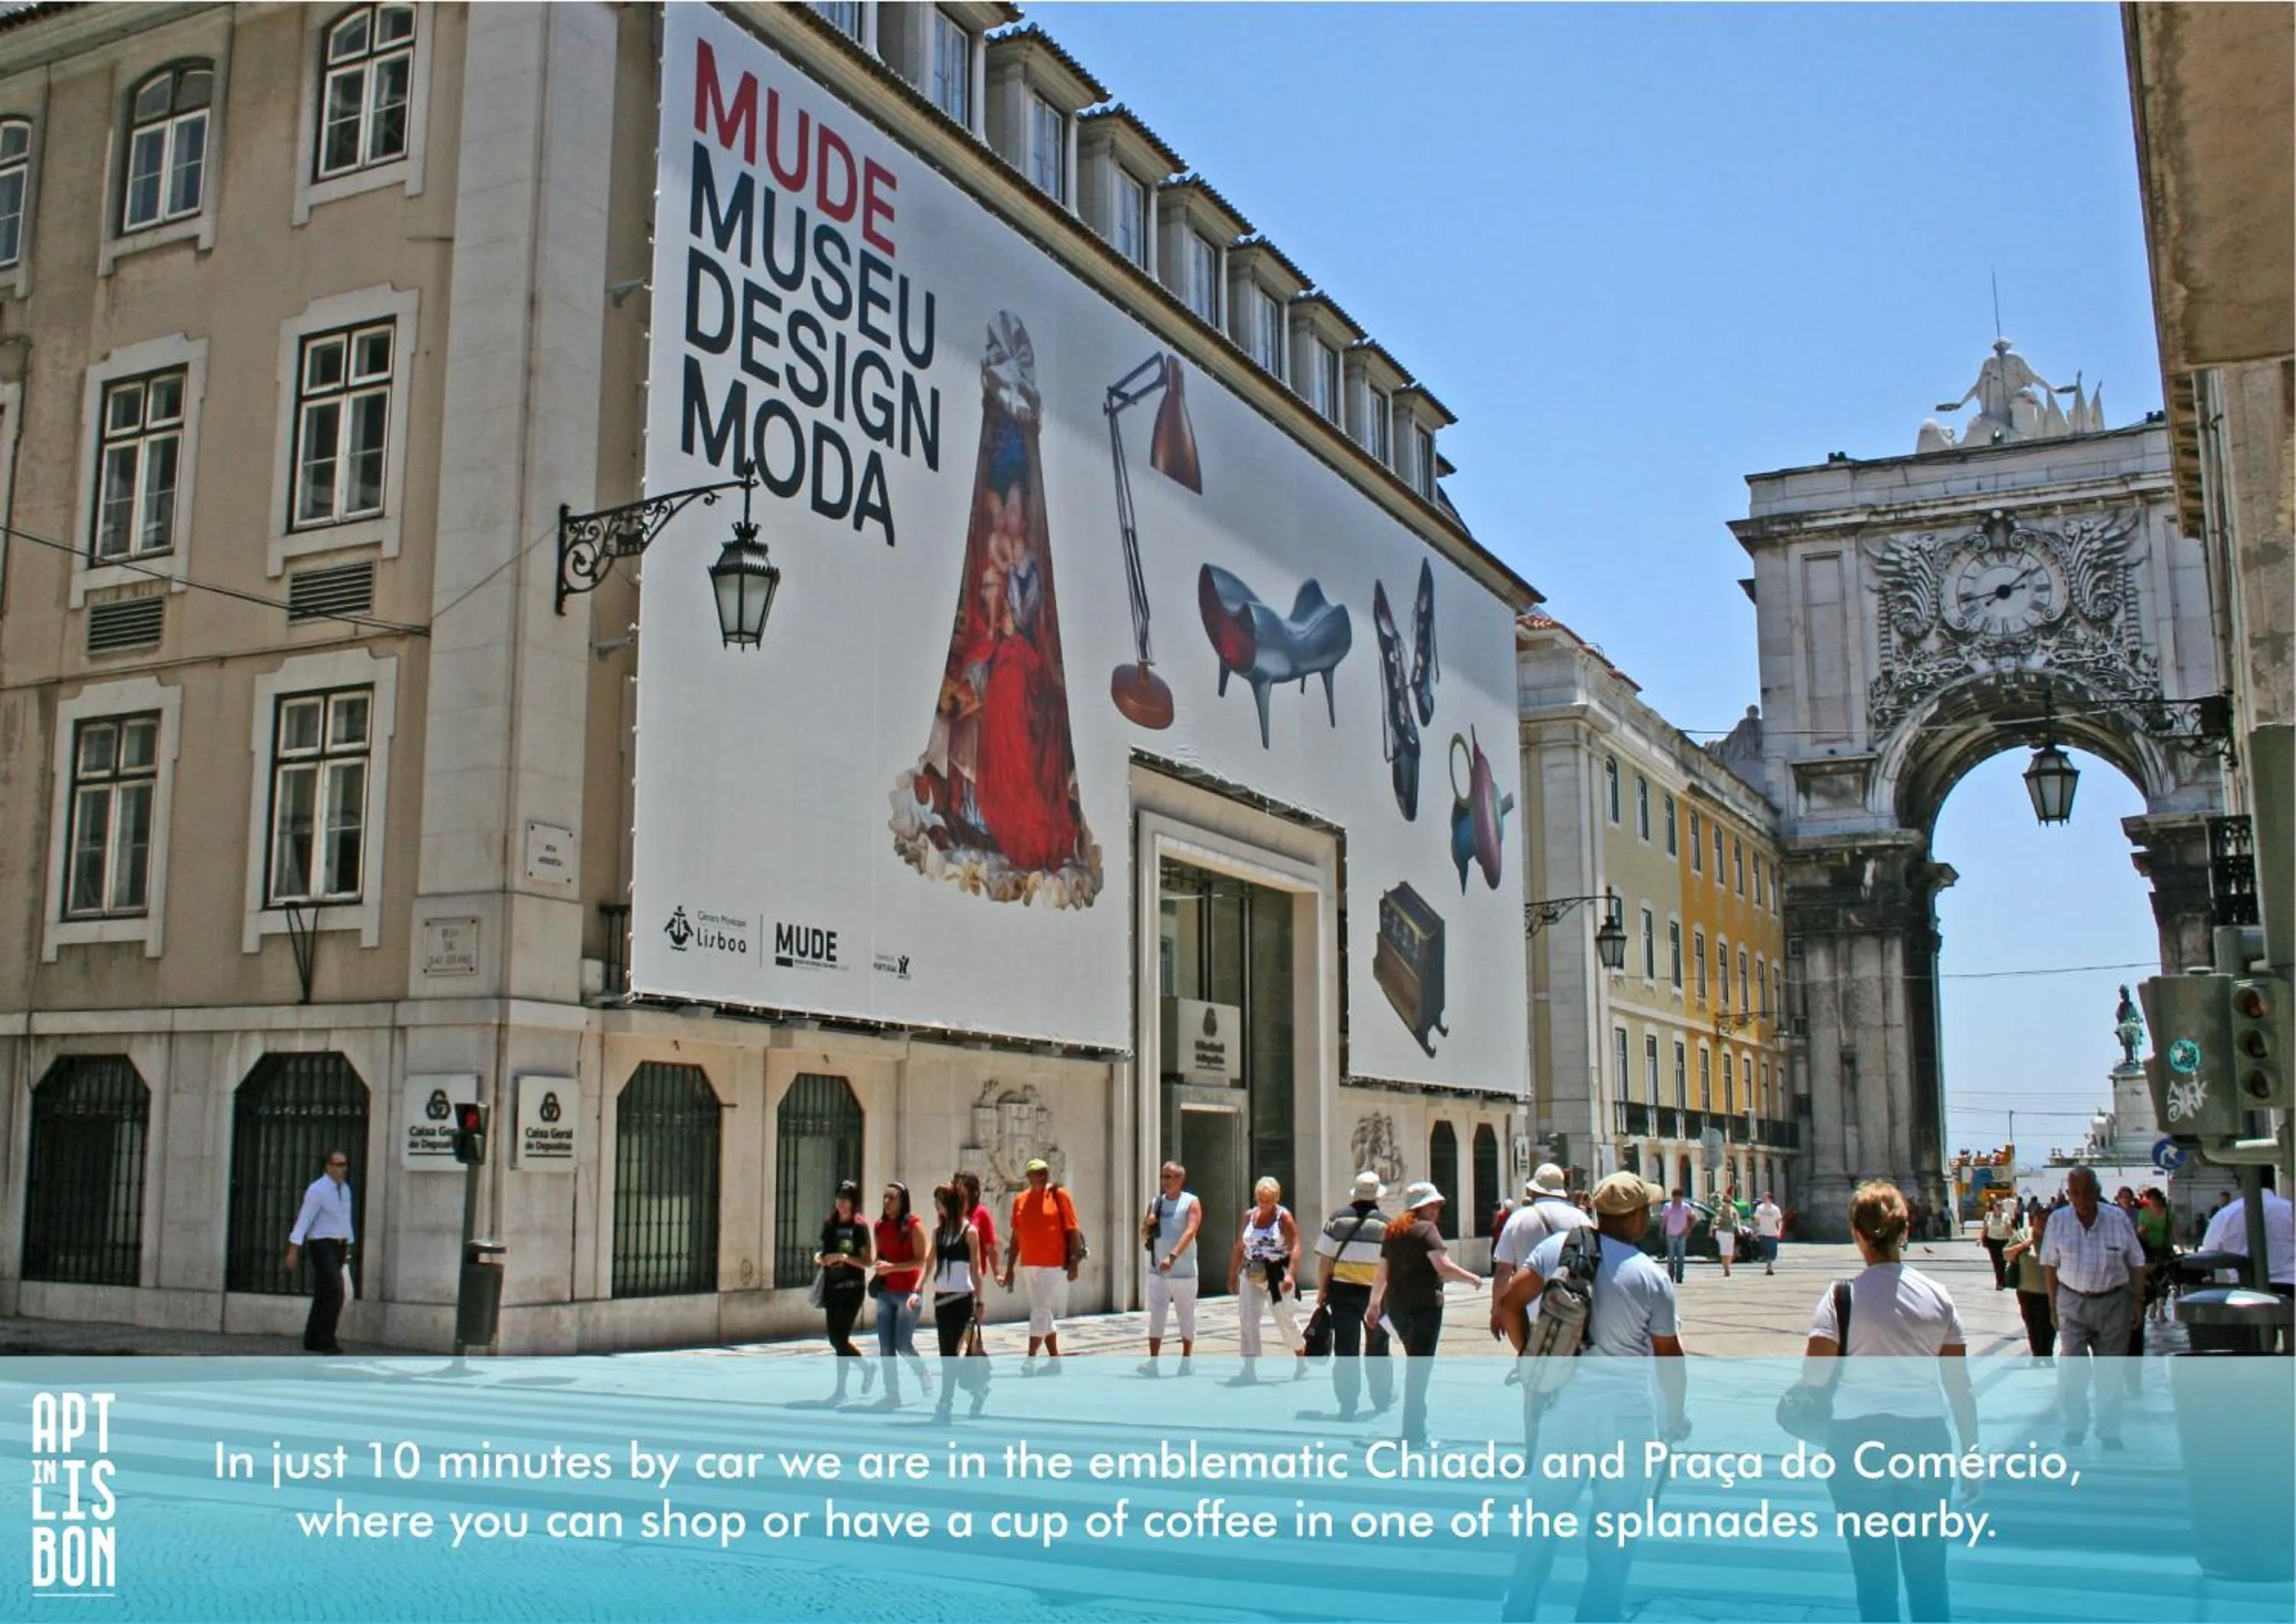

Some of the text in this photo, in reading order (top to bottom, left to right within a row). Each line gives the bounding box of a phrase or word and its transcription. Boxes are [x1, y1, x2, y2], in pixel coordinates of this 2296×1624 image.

[693, 38, 897, 259] MUDE
[689, 140, 935, 370] MUSEU
[681, 354, 895, 547] MODA
[685, 245, 940, 472] DESIGN
[775, 921, 837, 962] MUDE
[409, 1126, 459, 1137] Caixa Ger
[525, 1127, 572, 1140] Caixa Geral
